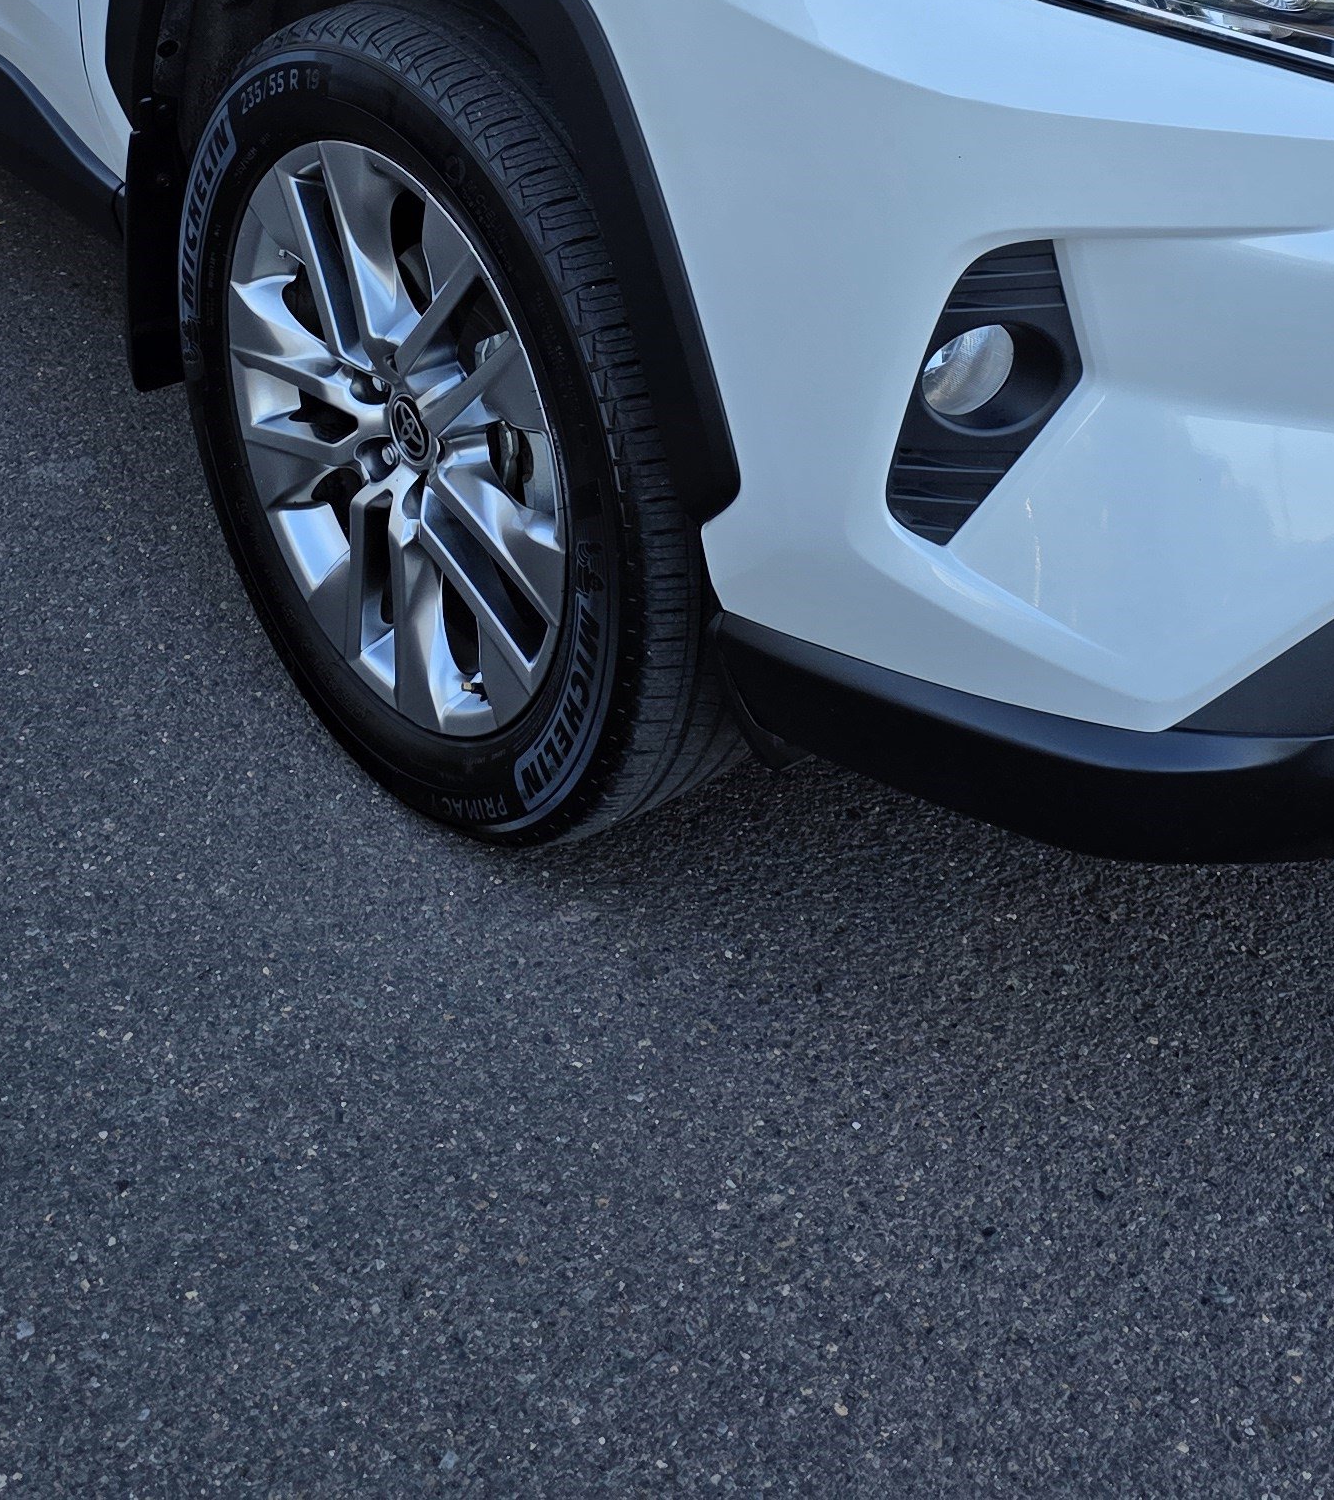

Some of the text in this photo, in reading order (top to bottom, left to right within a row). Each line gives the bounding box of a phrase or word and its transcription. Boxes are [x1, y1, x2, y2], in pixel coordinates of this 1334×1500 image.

[240, 68, 320, 115] 235/55 R 19
[181, 117, 232, 311] MICHELIN
[520, 609, 603, 802] MICHELIN
